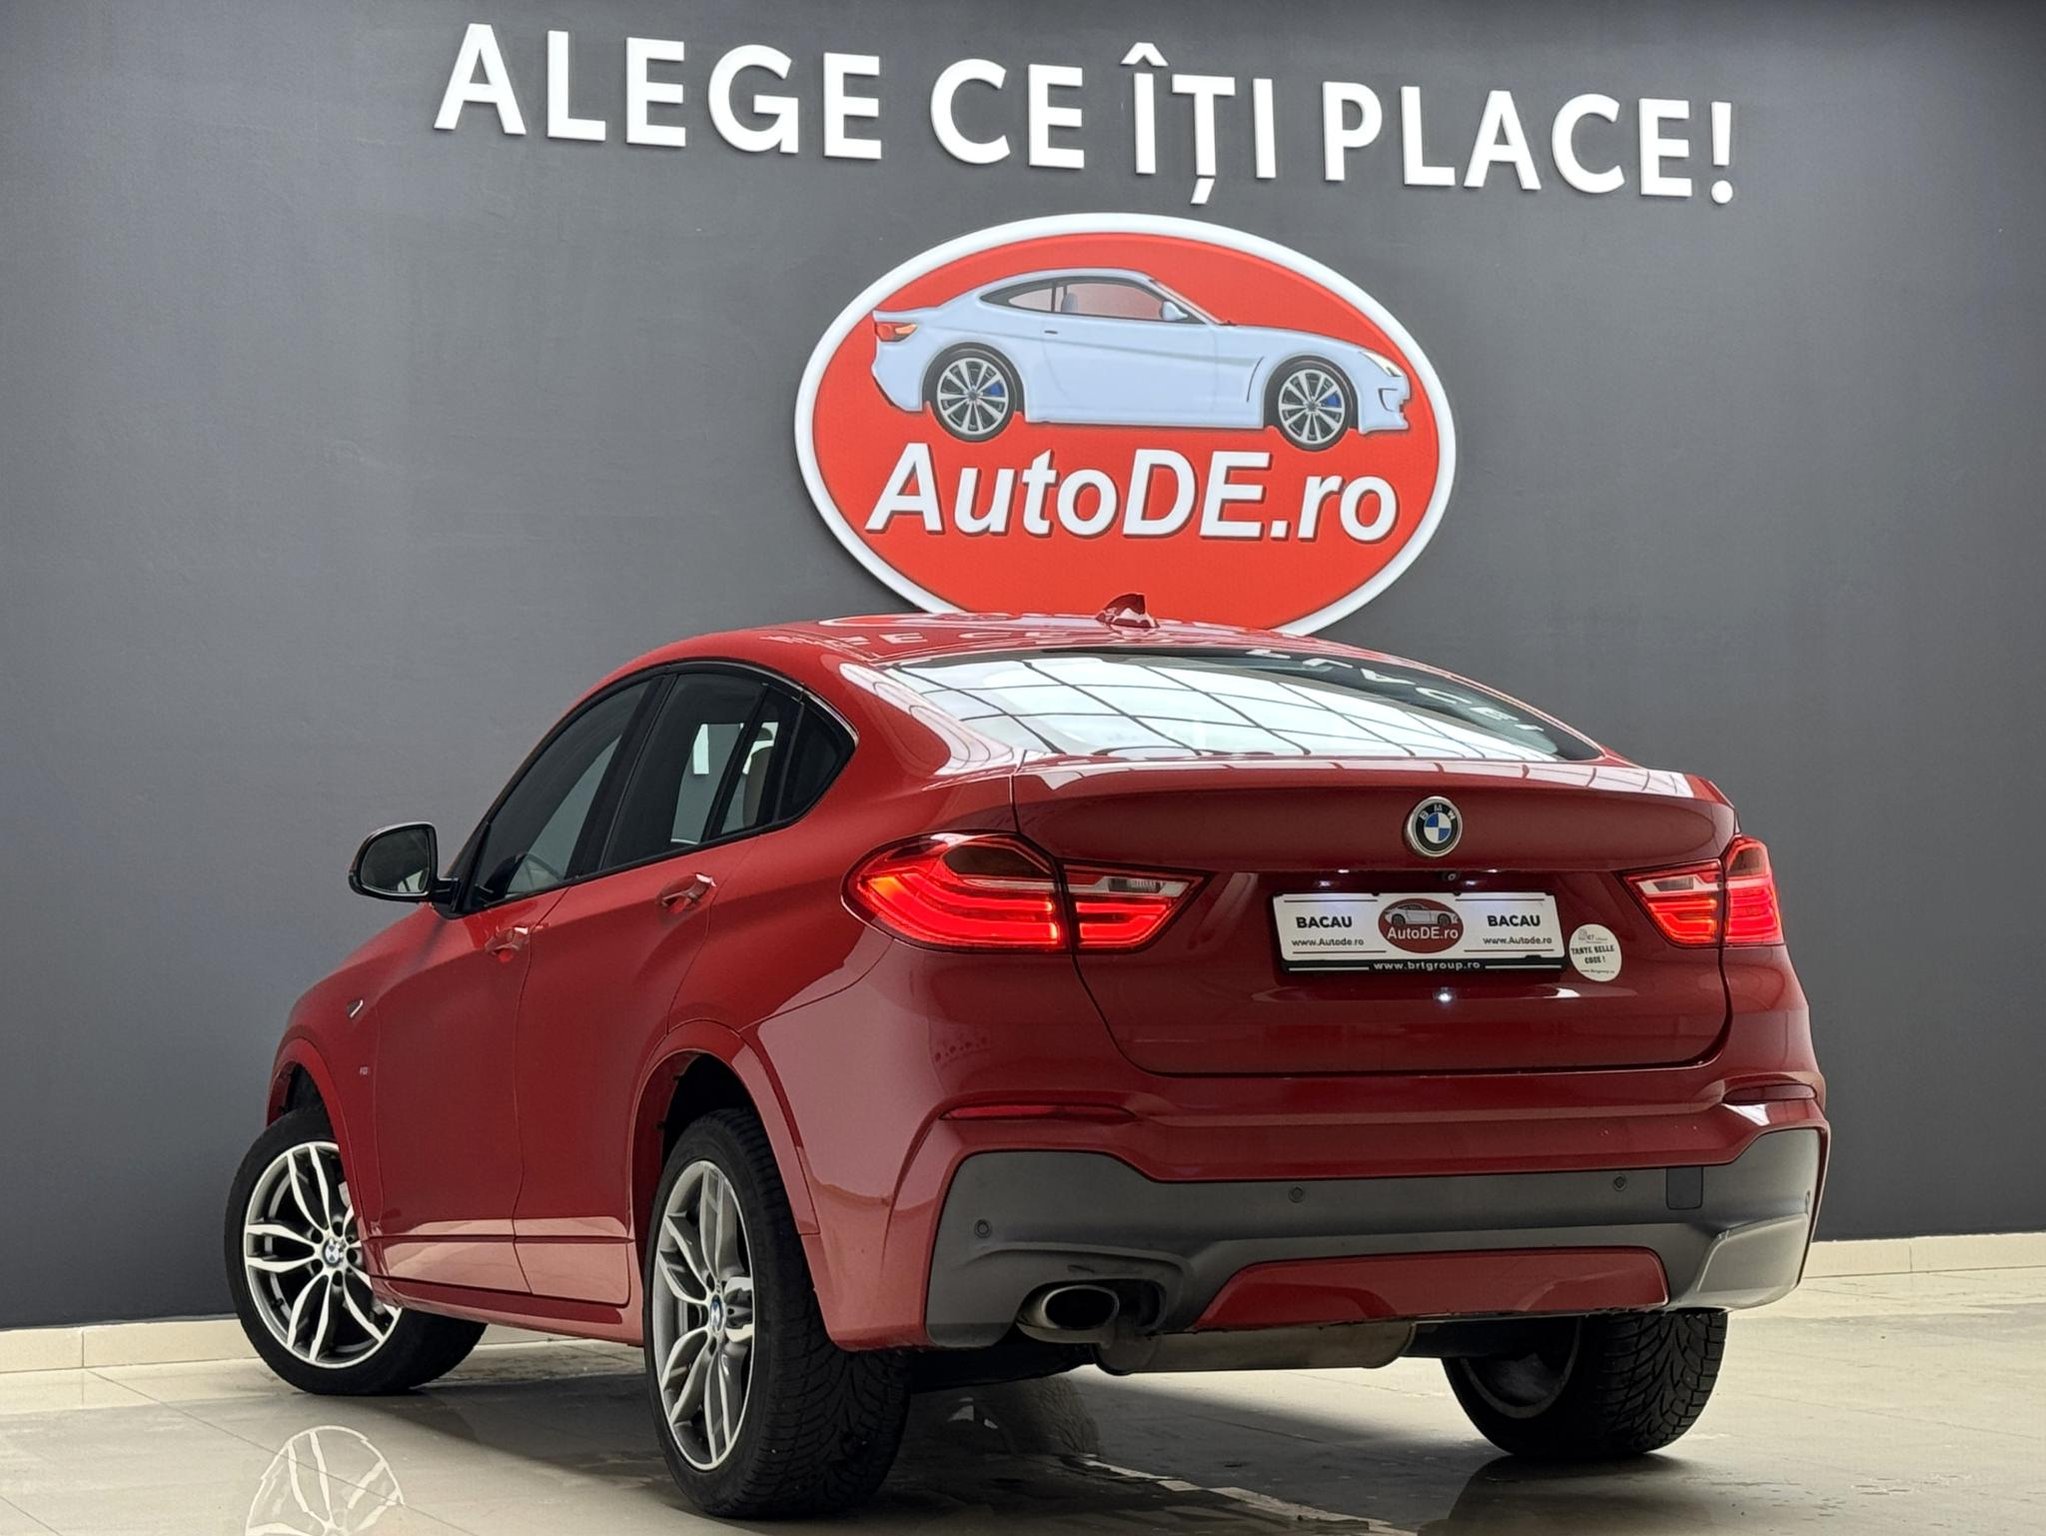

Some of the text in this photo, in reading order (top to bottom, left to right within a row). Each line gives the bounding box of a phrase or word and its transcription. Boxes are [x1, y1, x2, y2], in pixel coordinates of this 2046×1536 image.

[434, 23, 1734, 205] ALEGE CE ÎȚI PLACE!
[866, 443, 1396, 541] AutoDE.ro
[1296, 916, 1353, 929] BACAU
[1486, 915, 1541, 928] BACAU
[1387, 926, 1459, 940] AutoDE.ro
[1373, 961, 1481, 972] www.brtgroup.ro
